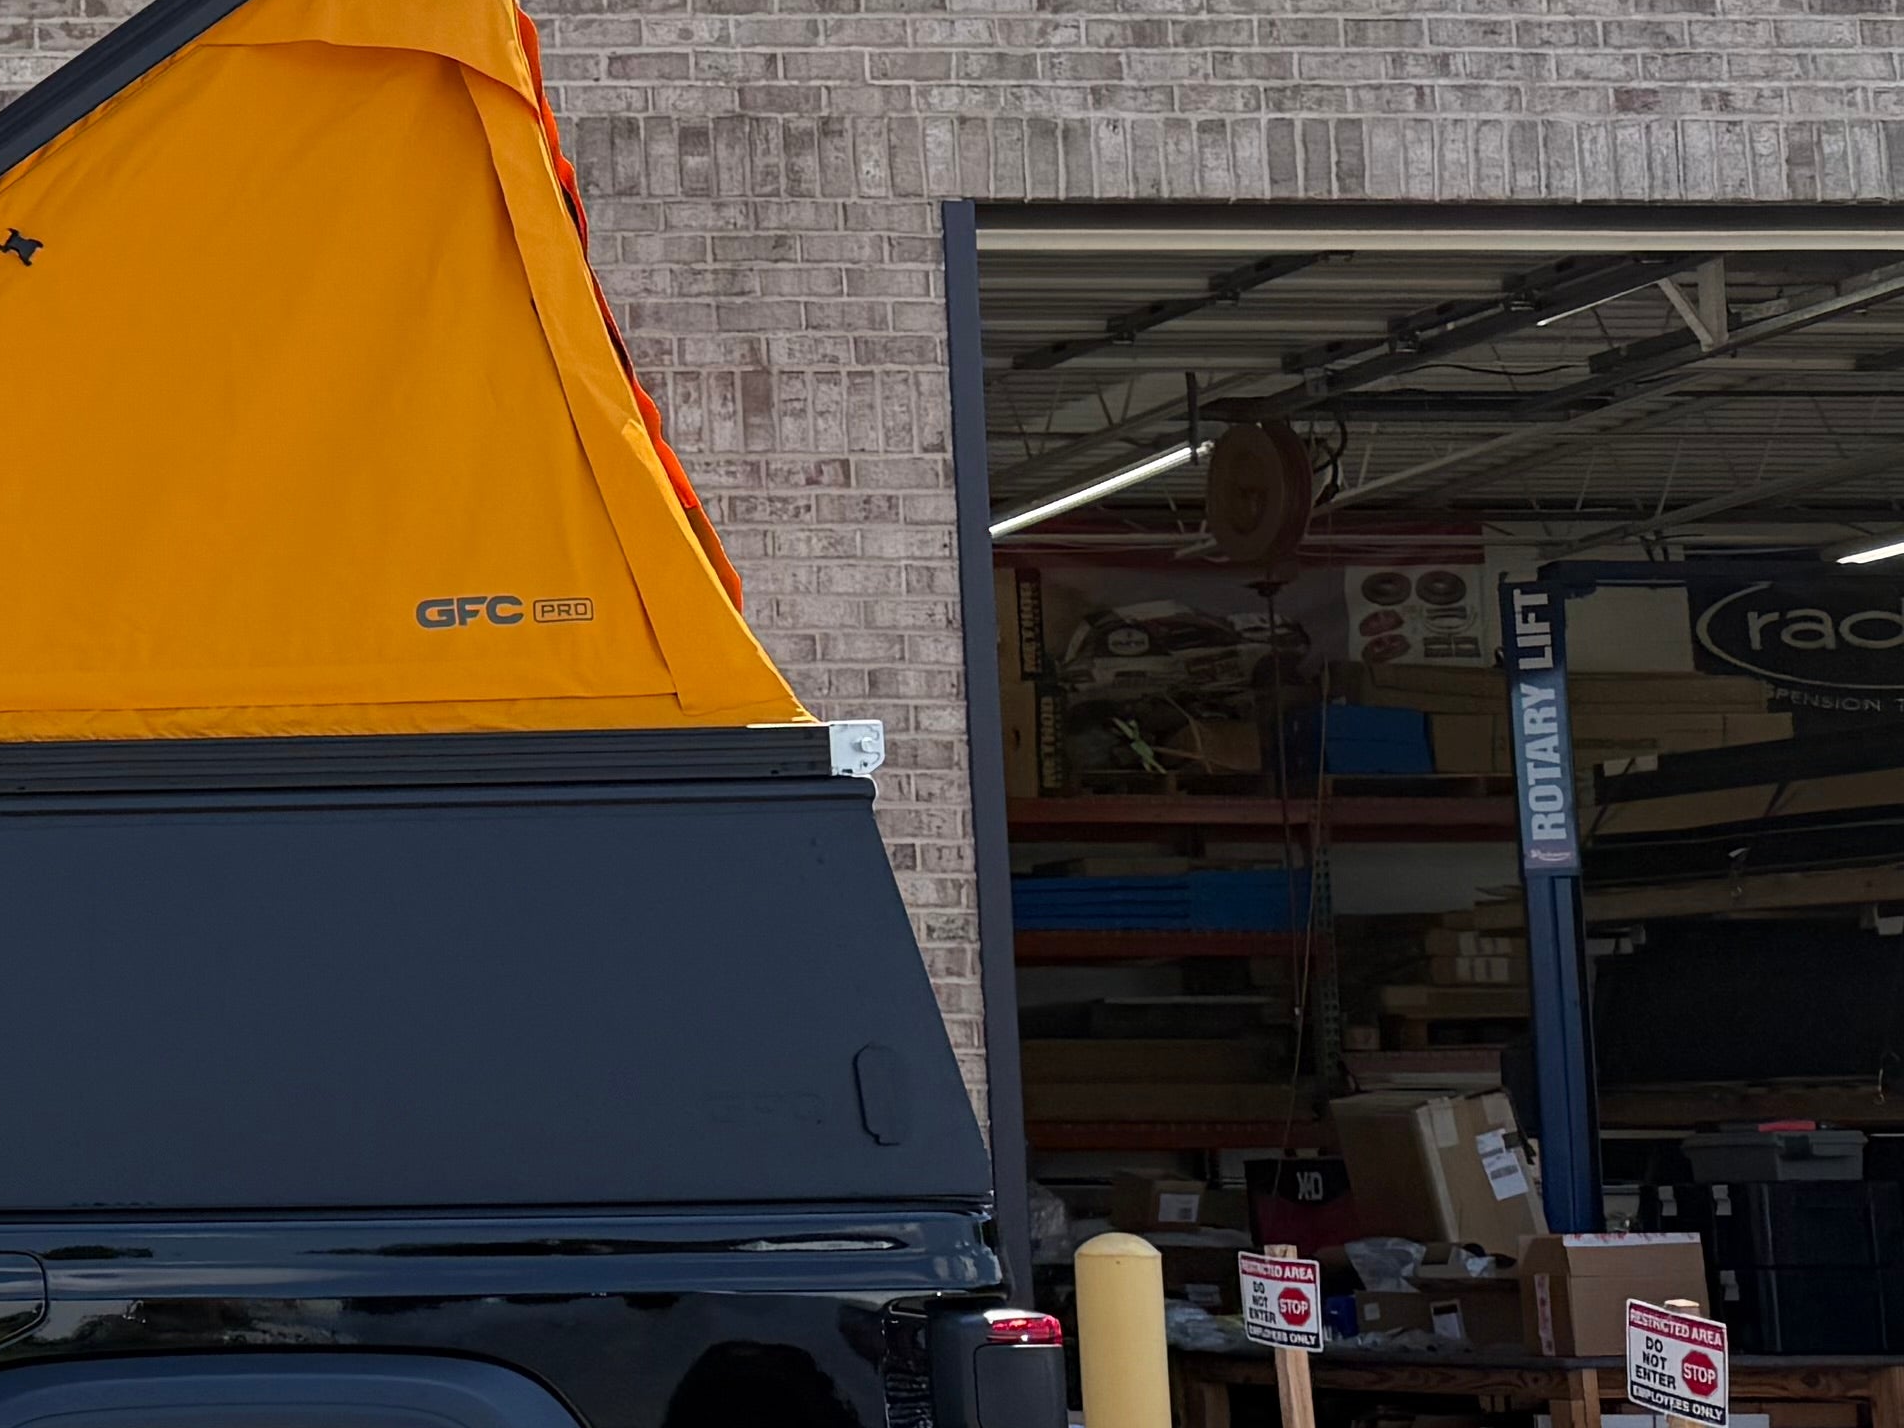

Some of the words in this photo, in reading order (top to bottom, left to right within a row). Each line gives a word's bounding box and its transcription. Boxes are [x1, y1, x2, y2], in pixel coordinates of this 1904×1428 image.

[415, 594, 525, 629] GFC
[540, 602, 588, 618] PRO
[1512, 587, 1554, 670] LIFT
[1519, 682, 1567, 842] ROTARY
[1283, 1265, 1314, 1281] AREA
[1252, 1280, 1265, 1294] DO
[1252, 1295, 1268, 1308] NOT
[1279, 1298, 1309, 1315] STOP
[1249, 1307, 1277, 1325] ENTER
[1630, 1308, 1690, 1339] RESTRICTED
[1691, 1327, 1723, 1346] AREA
[1289, 1333, 1317, 1346] ONLY
[1645, 1335, 1664, 1353] DO
[1642, 1351, 1668, 1371] NOT
[1635, 1364, 1677, 1390] ENTER
[1683, 1362, 1717, 1385] STOP
[1632, 1384, 1690, 1413] EMPLOYEES
[1691, 1403, 1724, 1421] ONLY
